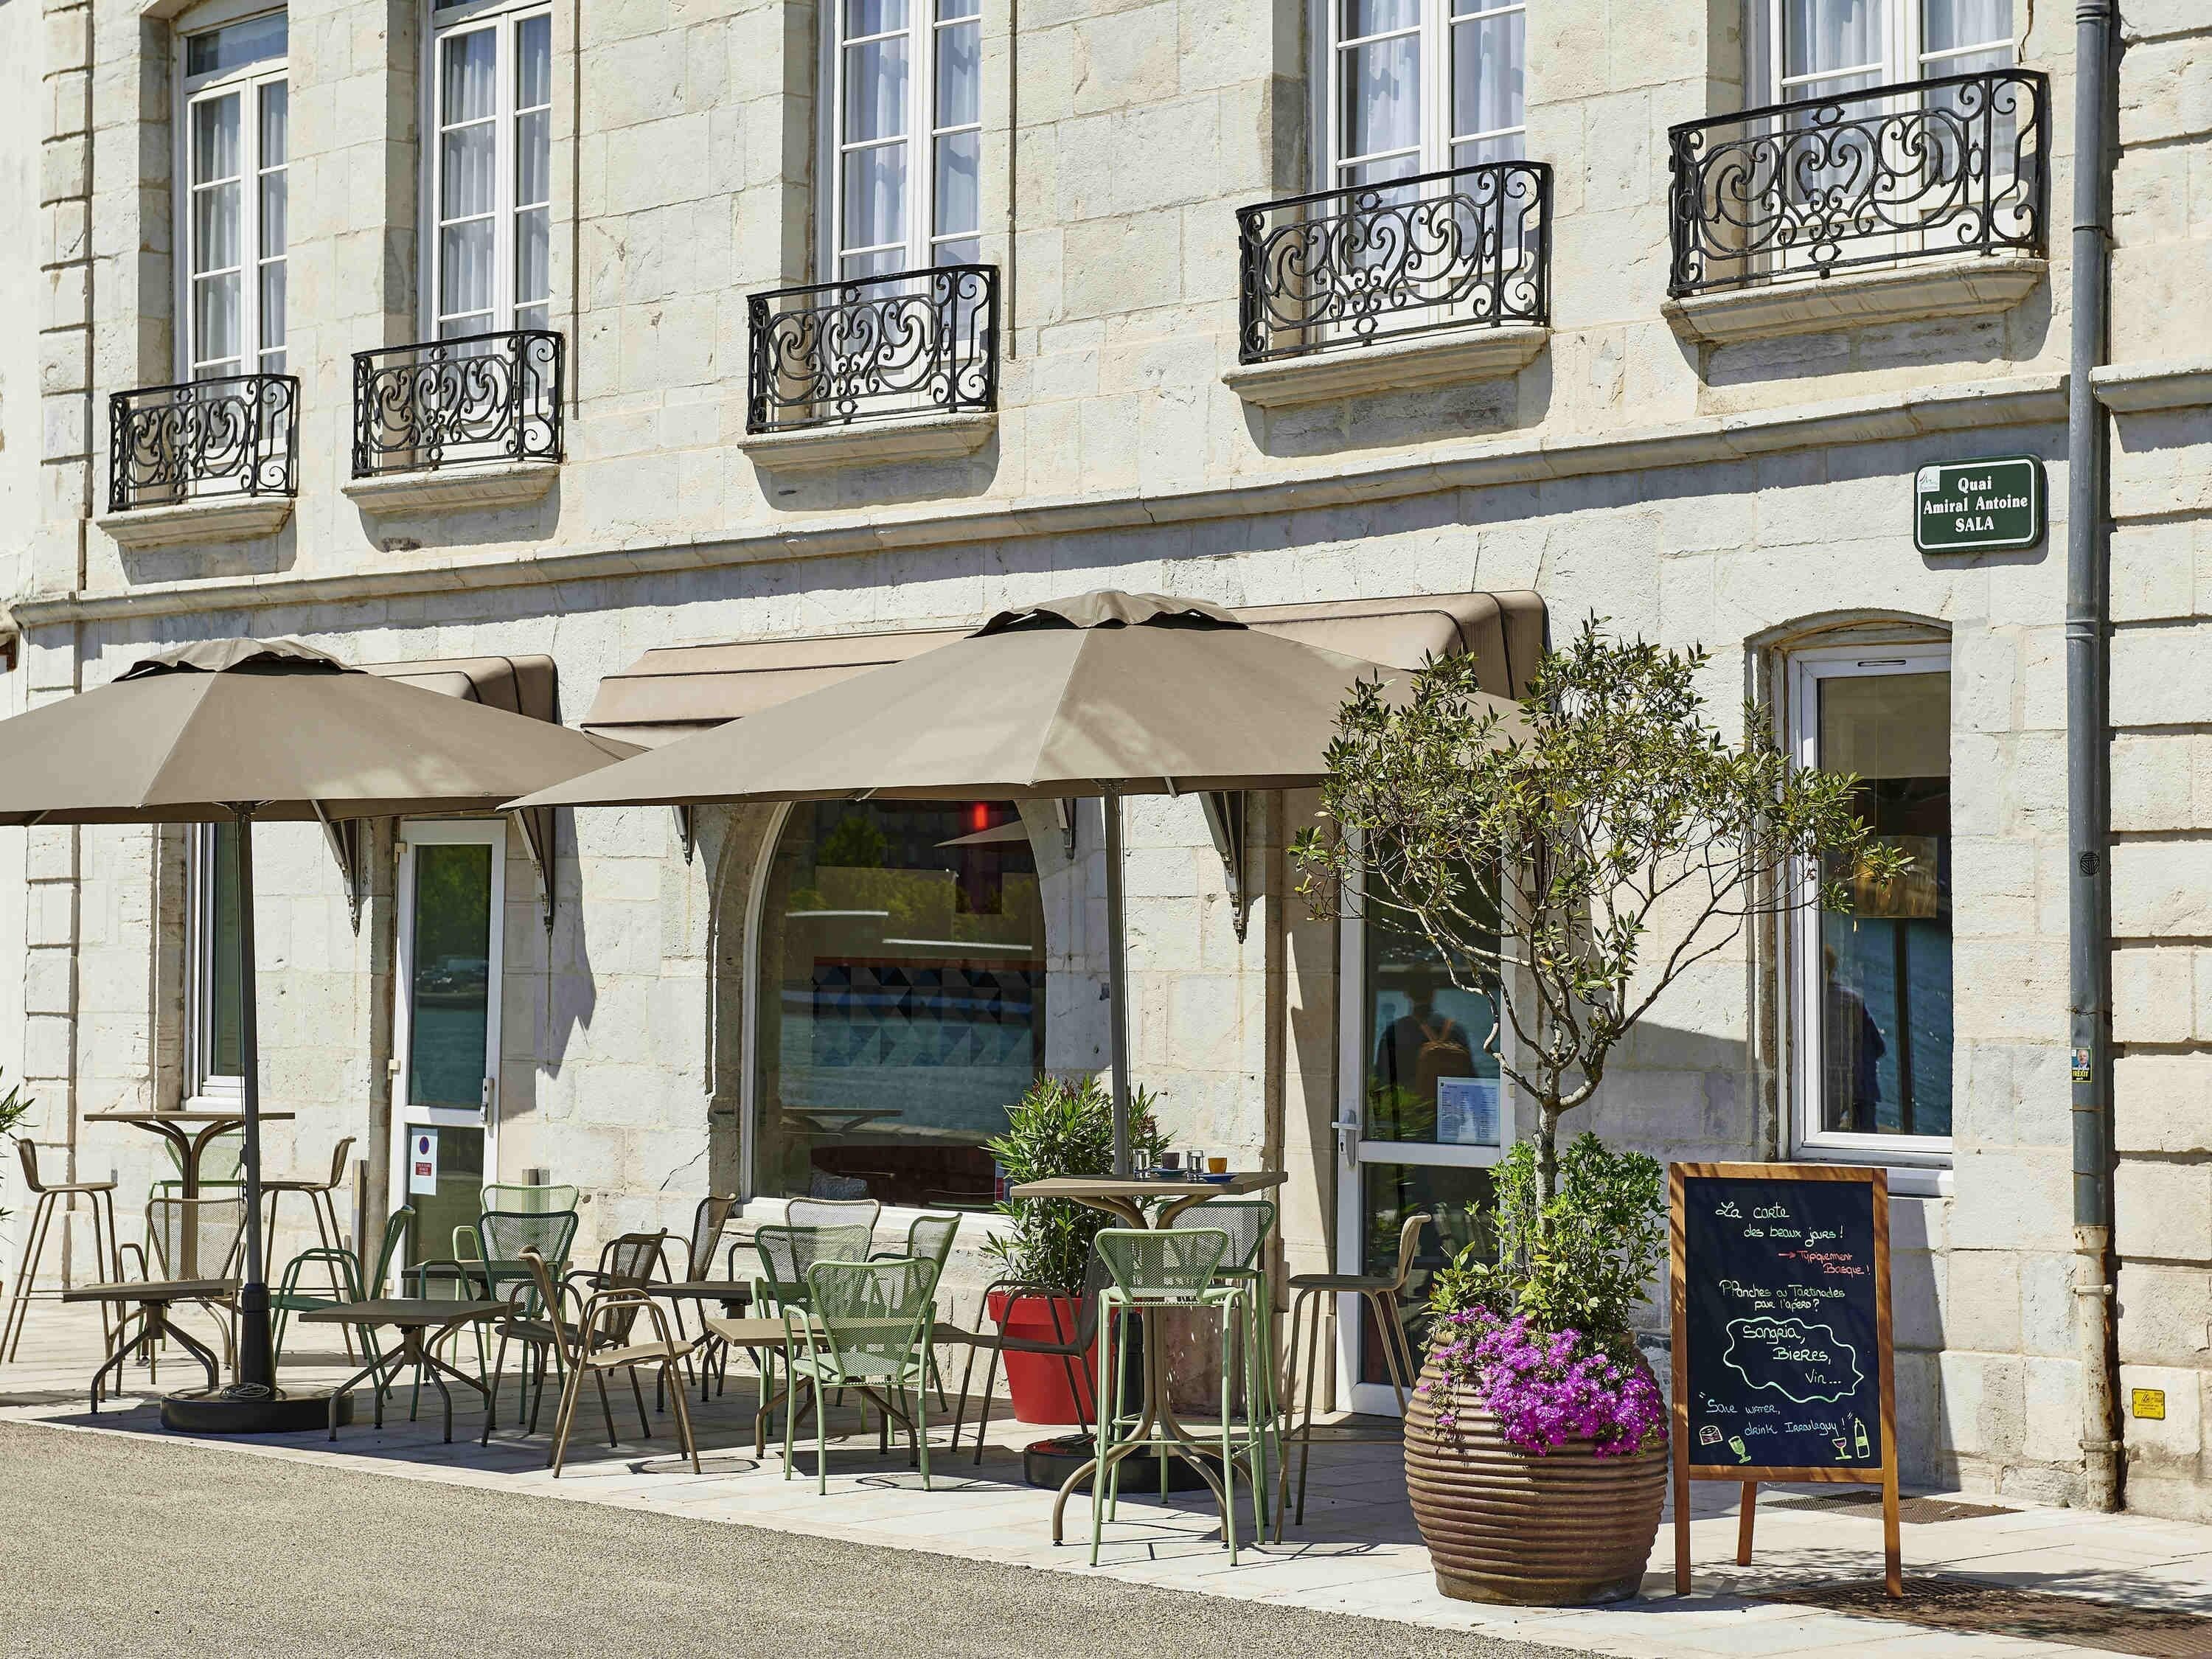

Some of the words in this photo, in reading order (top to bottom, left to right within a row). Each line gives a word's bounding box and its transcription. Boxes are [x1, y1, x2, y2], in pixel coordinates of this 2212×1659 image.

[1958, 476, 1992, 493] Quai
[1923, 497, 1969, 515] Amiral
[1975, 494, 2028, 511] Antoine
[1955, 516, 1994, 532] SALA
[1715, 1201, 1743, 1219] La
[1753, 1202, 1790, 1219] carte
[1743, 1223, 1764, 1237] des
[1770, 1225, 1802, 1238] beaux
[1823, 1262, 1865, 1278] Basque
[1787, 1284, 1846, 1298] Tartinades
[1742, 1325, 1806, 1345] Sangria,
[1745, 1422, 1778, 1436] drink
